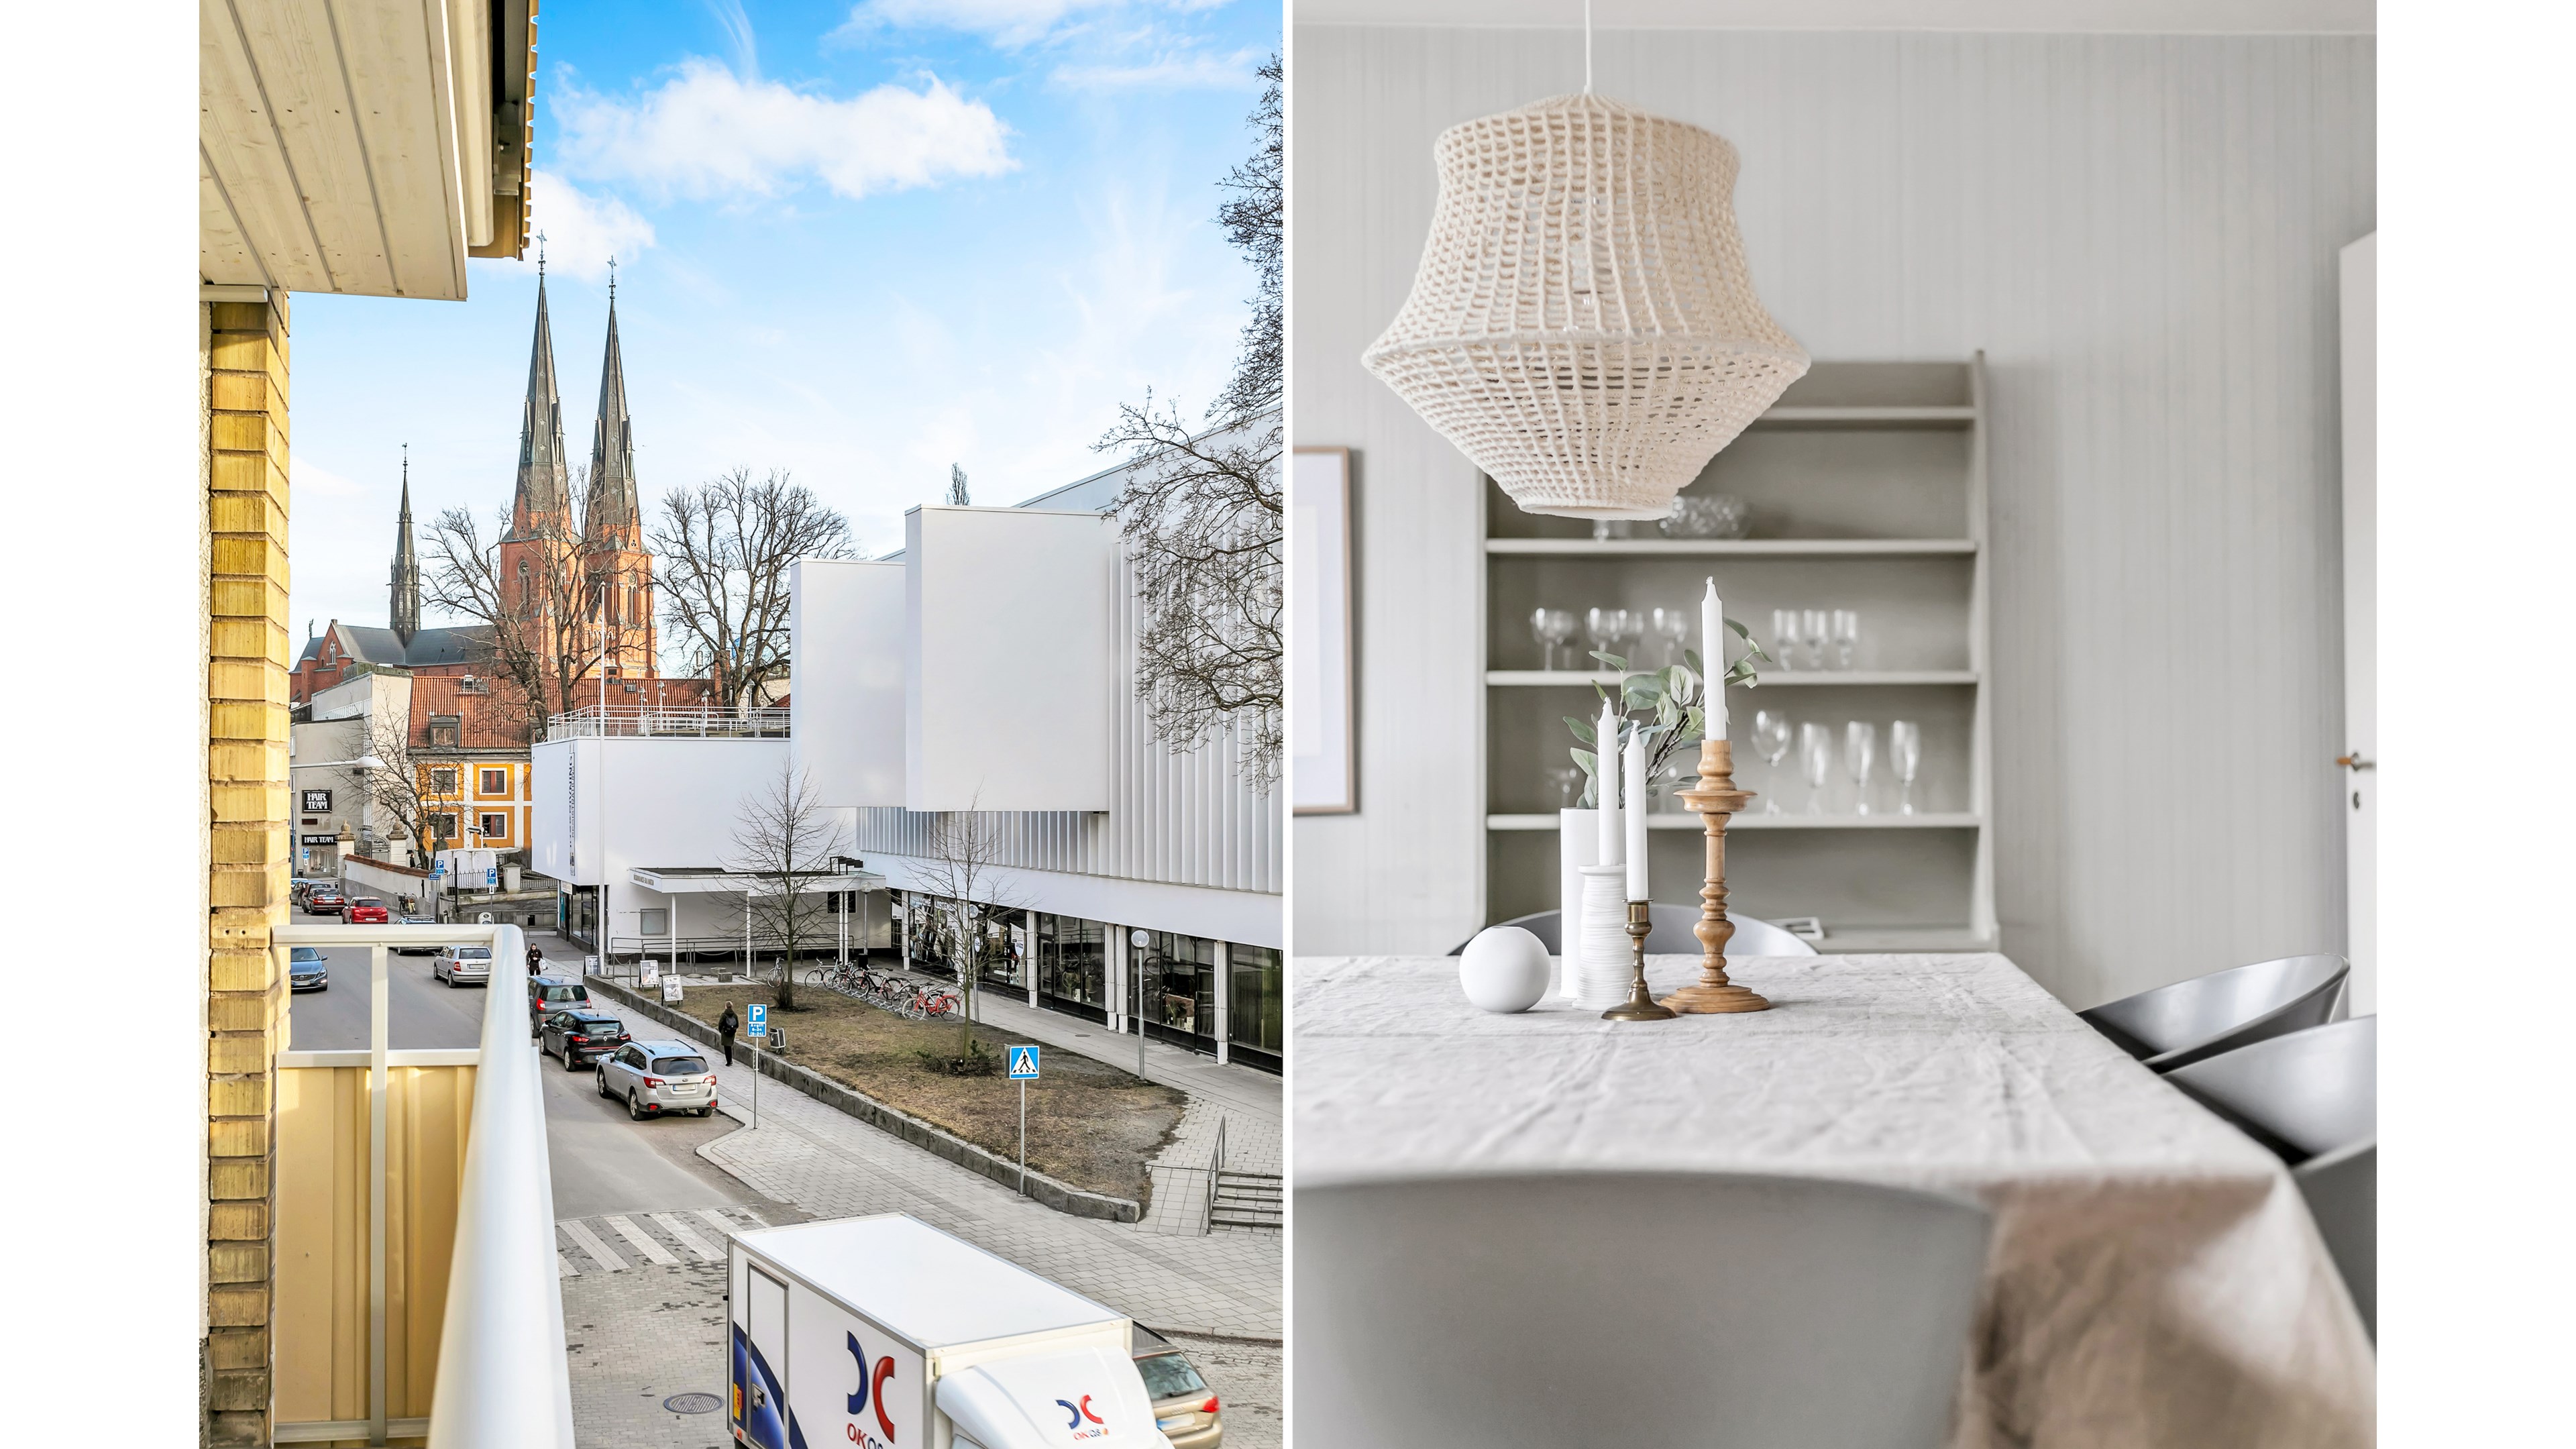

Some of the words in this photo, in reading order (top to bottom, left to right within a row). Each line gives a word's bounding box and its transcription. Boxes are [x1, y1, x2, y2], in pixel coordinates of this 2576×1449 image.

[307, 793, 327, 801] HAIR
[307, 801, 327, 809] TEAM
[753, 1006, 763, 1021] P
